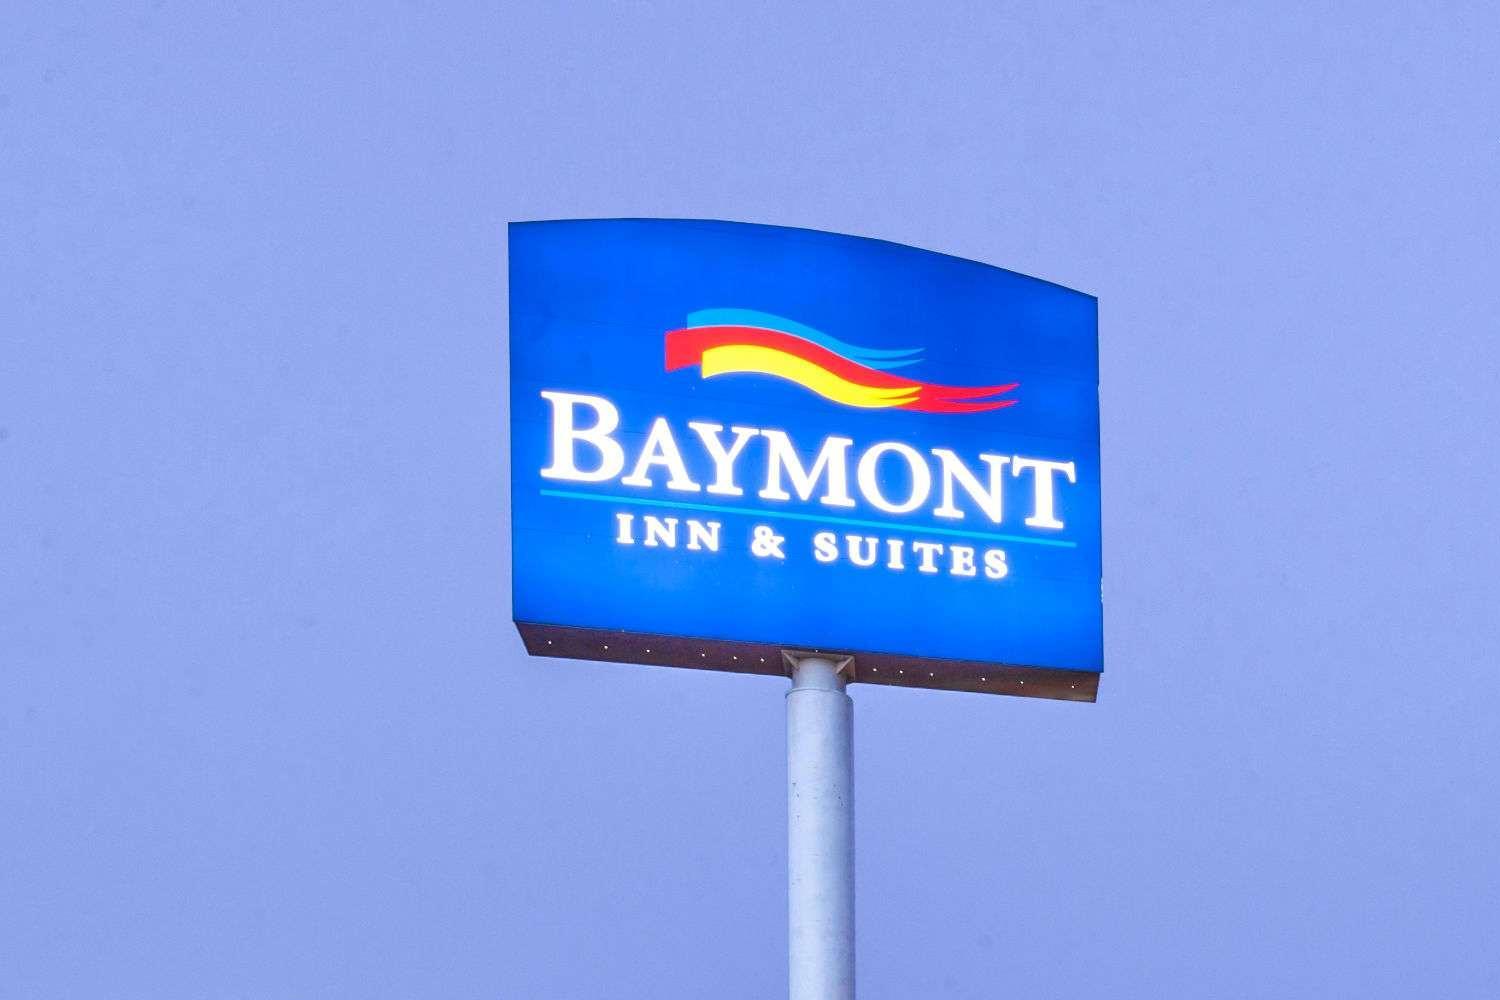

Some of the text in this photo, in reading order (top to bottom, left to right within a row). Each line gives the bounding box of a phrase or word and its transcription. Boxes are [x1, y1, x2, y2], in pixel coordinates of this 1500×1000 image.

[540, 390, 1077, 529] BAYMONT
[616, 512, 1009, 579] INN & SUITES
